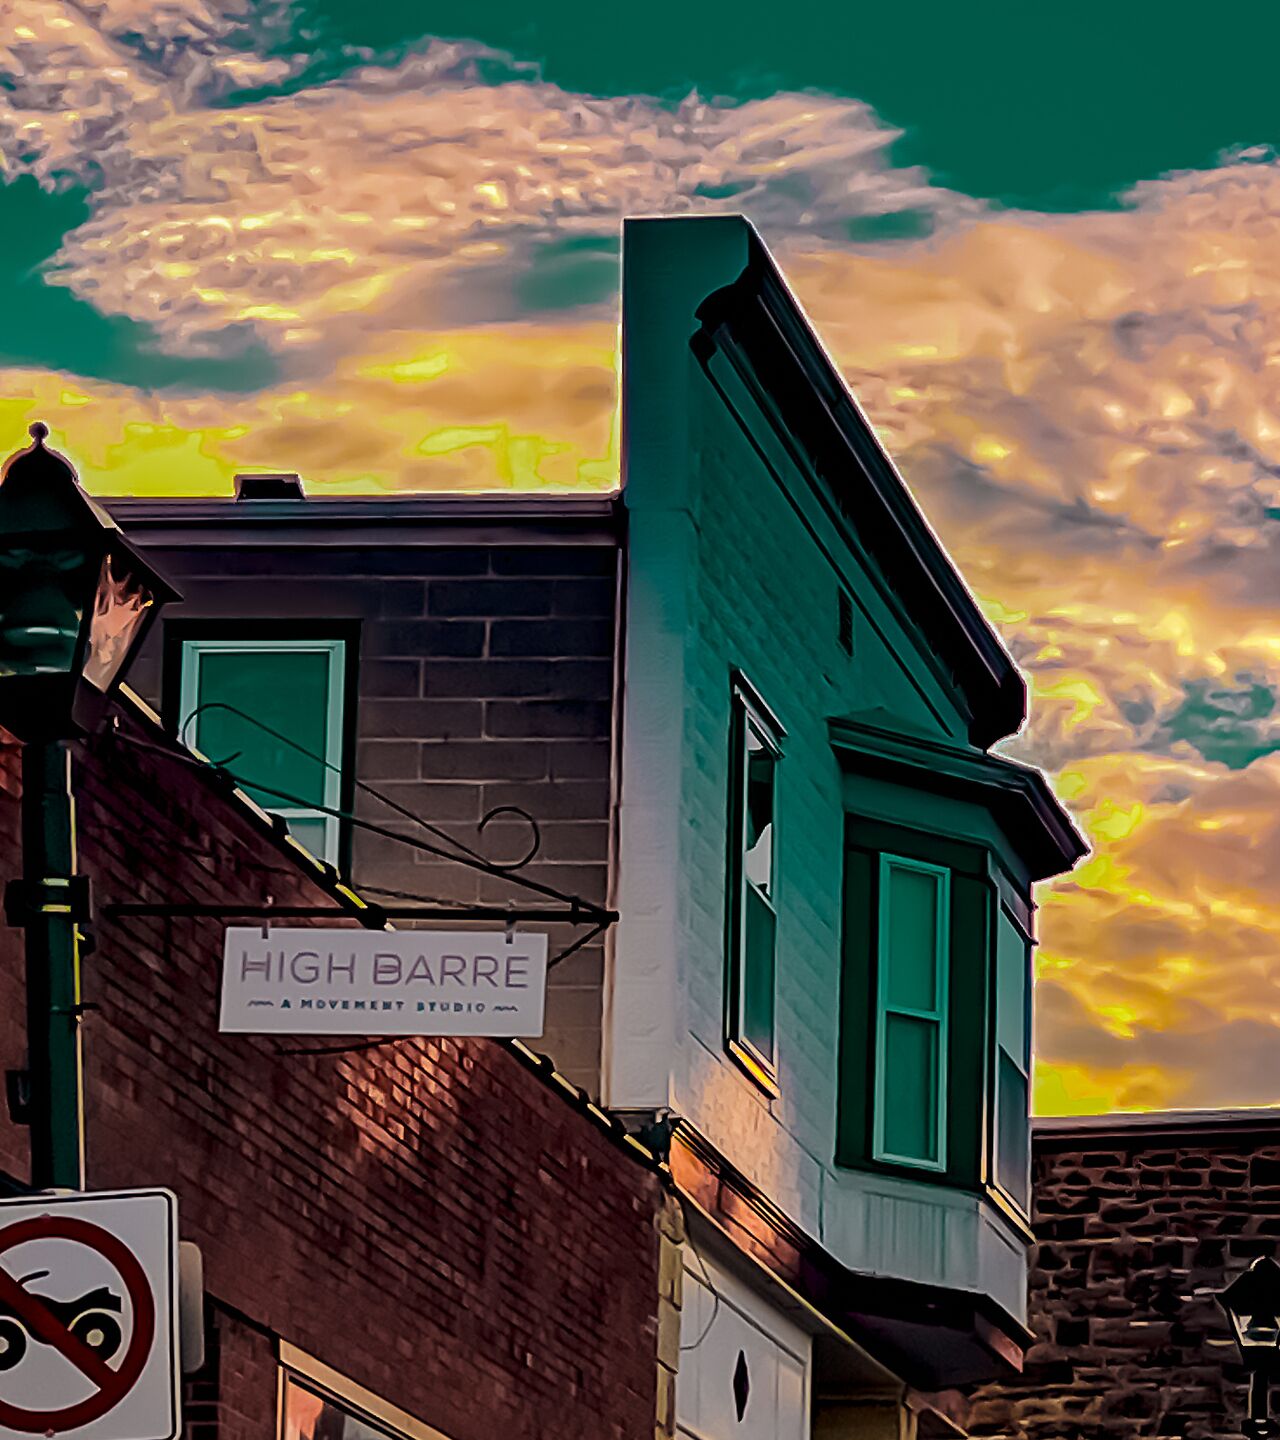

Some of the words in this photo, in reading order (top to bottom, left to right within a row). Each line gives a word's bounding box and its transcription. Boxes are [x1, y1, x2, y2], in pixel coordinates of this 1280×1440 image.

[240, 950, 356, 984] HIGH
[372, 953, 530, 988] BARRE
[280, 998, 292, 1009] A
[300, 998, 405, 1011] MOVEMENT
[416, 1002, 486, 1013] STUDIO
